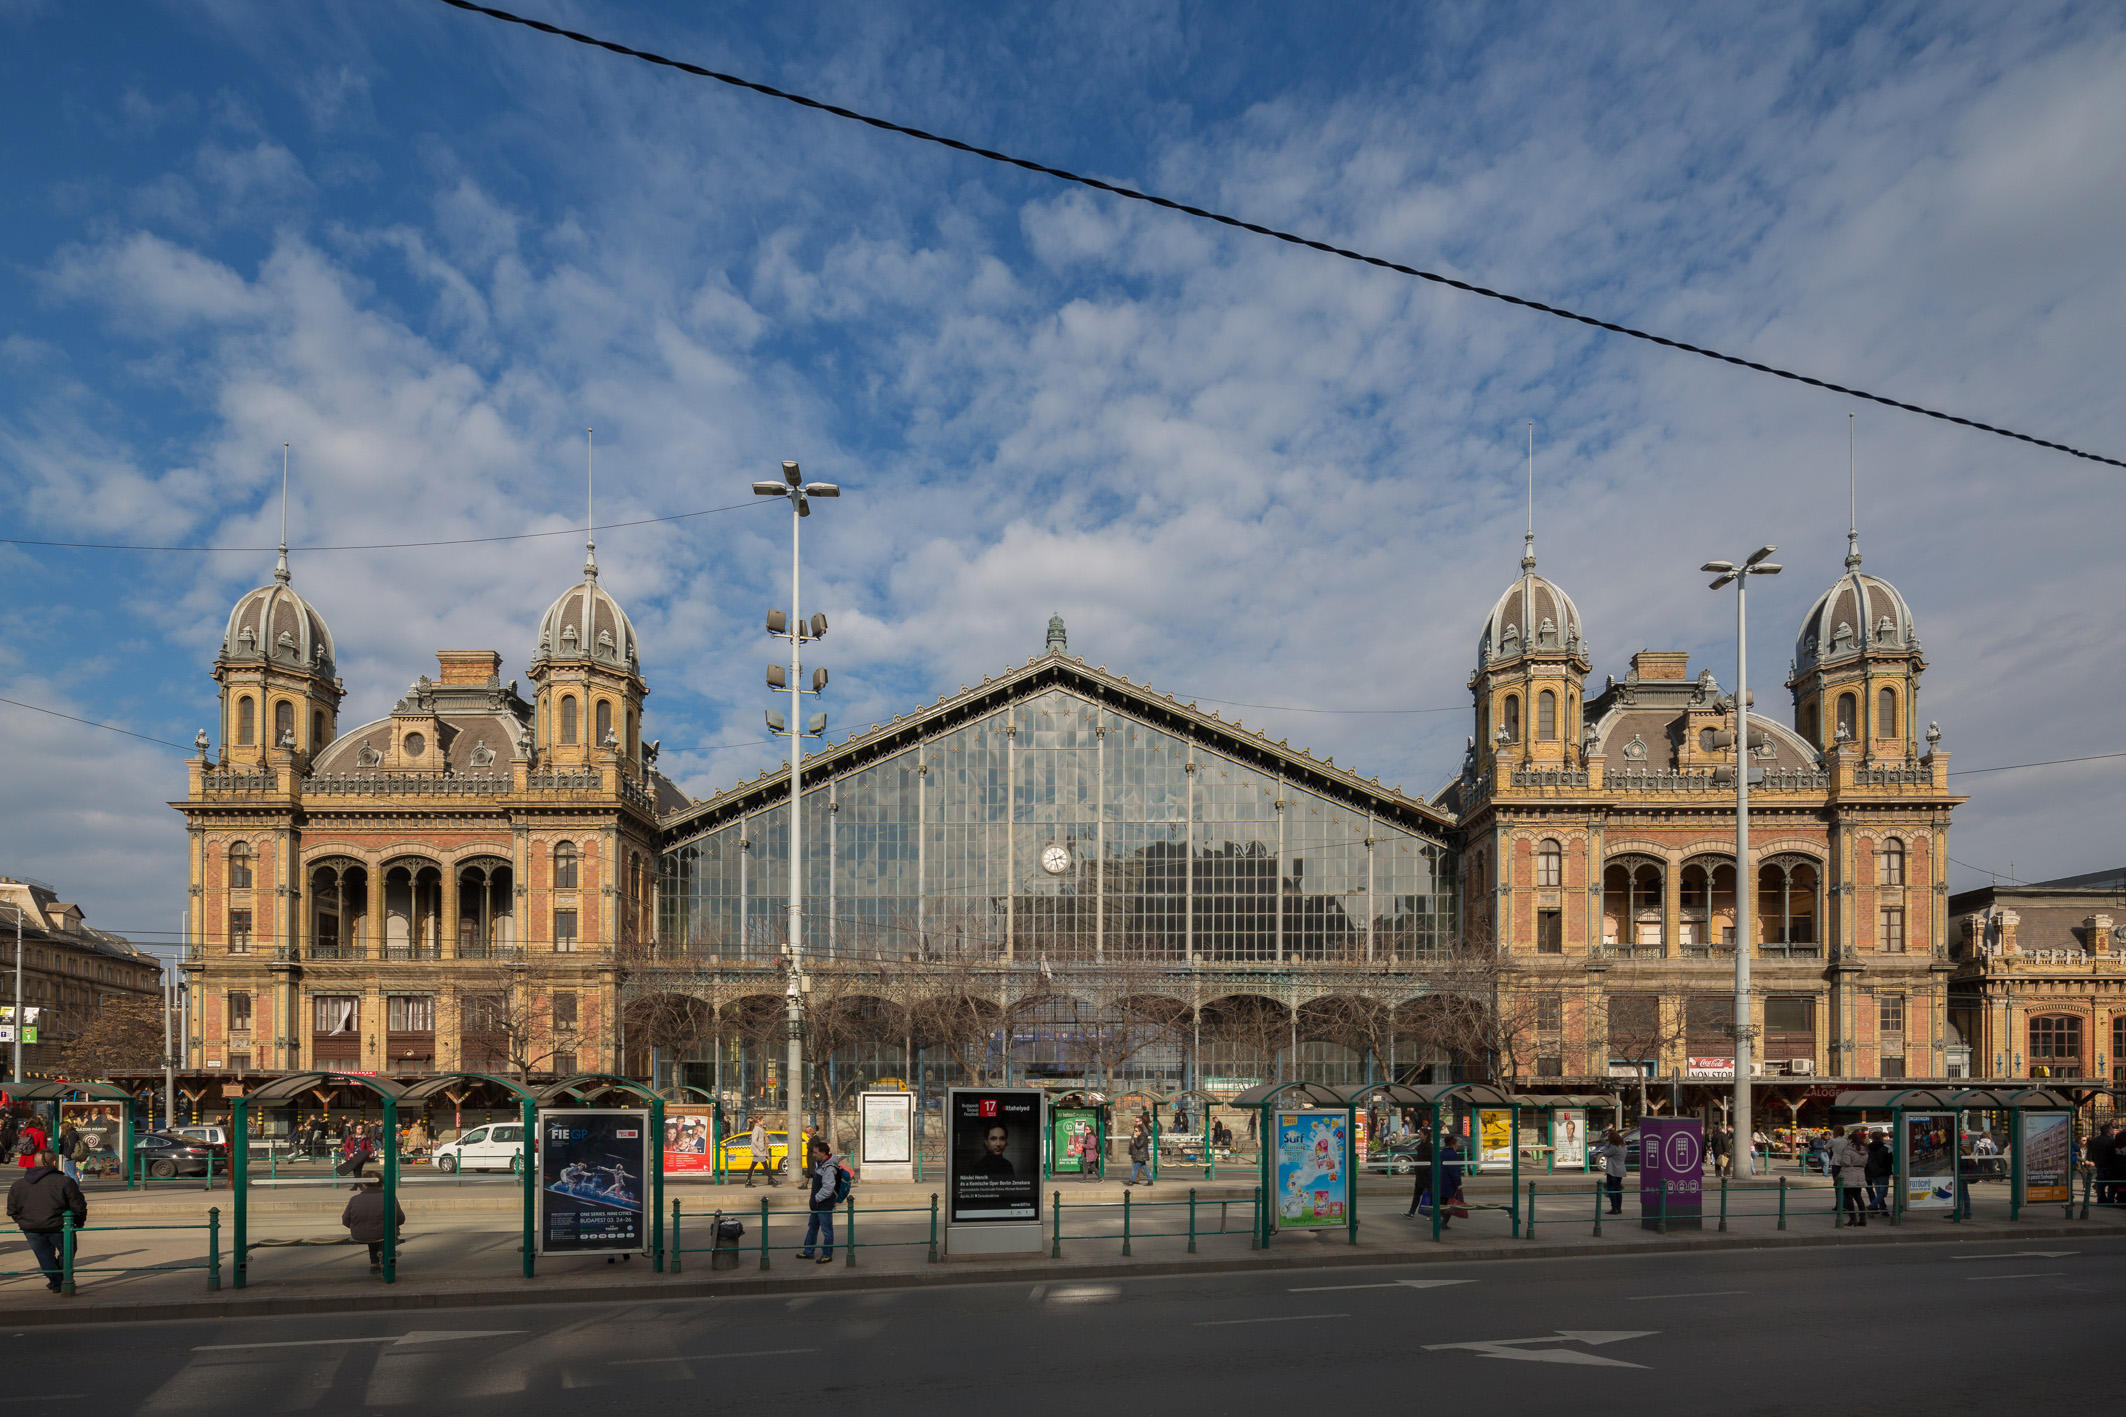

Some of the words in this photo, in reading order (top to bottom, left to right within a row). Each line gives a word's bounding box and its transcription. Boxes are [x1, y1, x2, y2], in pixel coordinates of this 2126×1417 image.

[984, 1101, 996, 1111] 17
[551, 1129, 569, 1140] FIE
[1284, 1133, 1304, 1144] Surf
